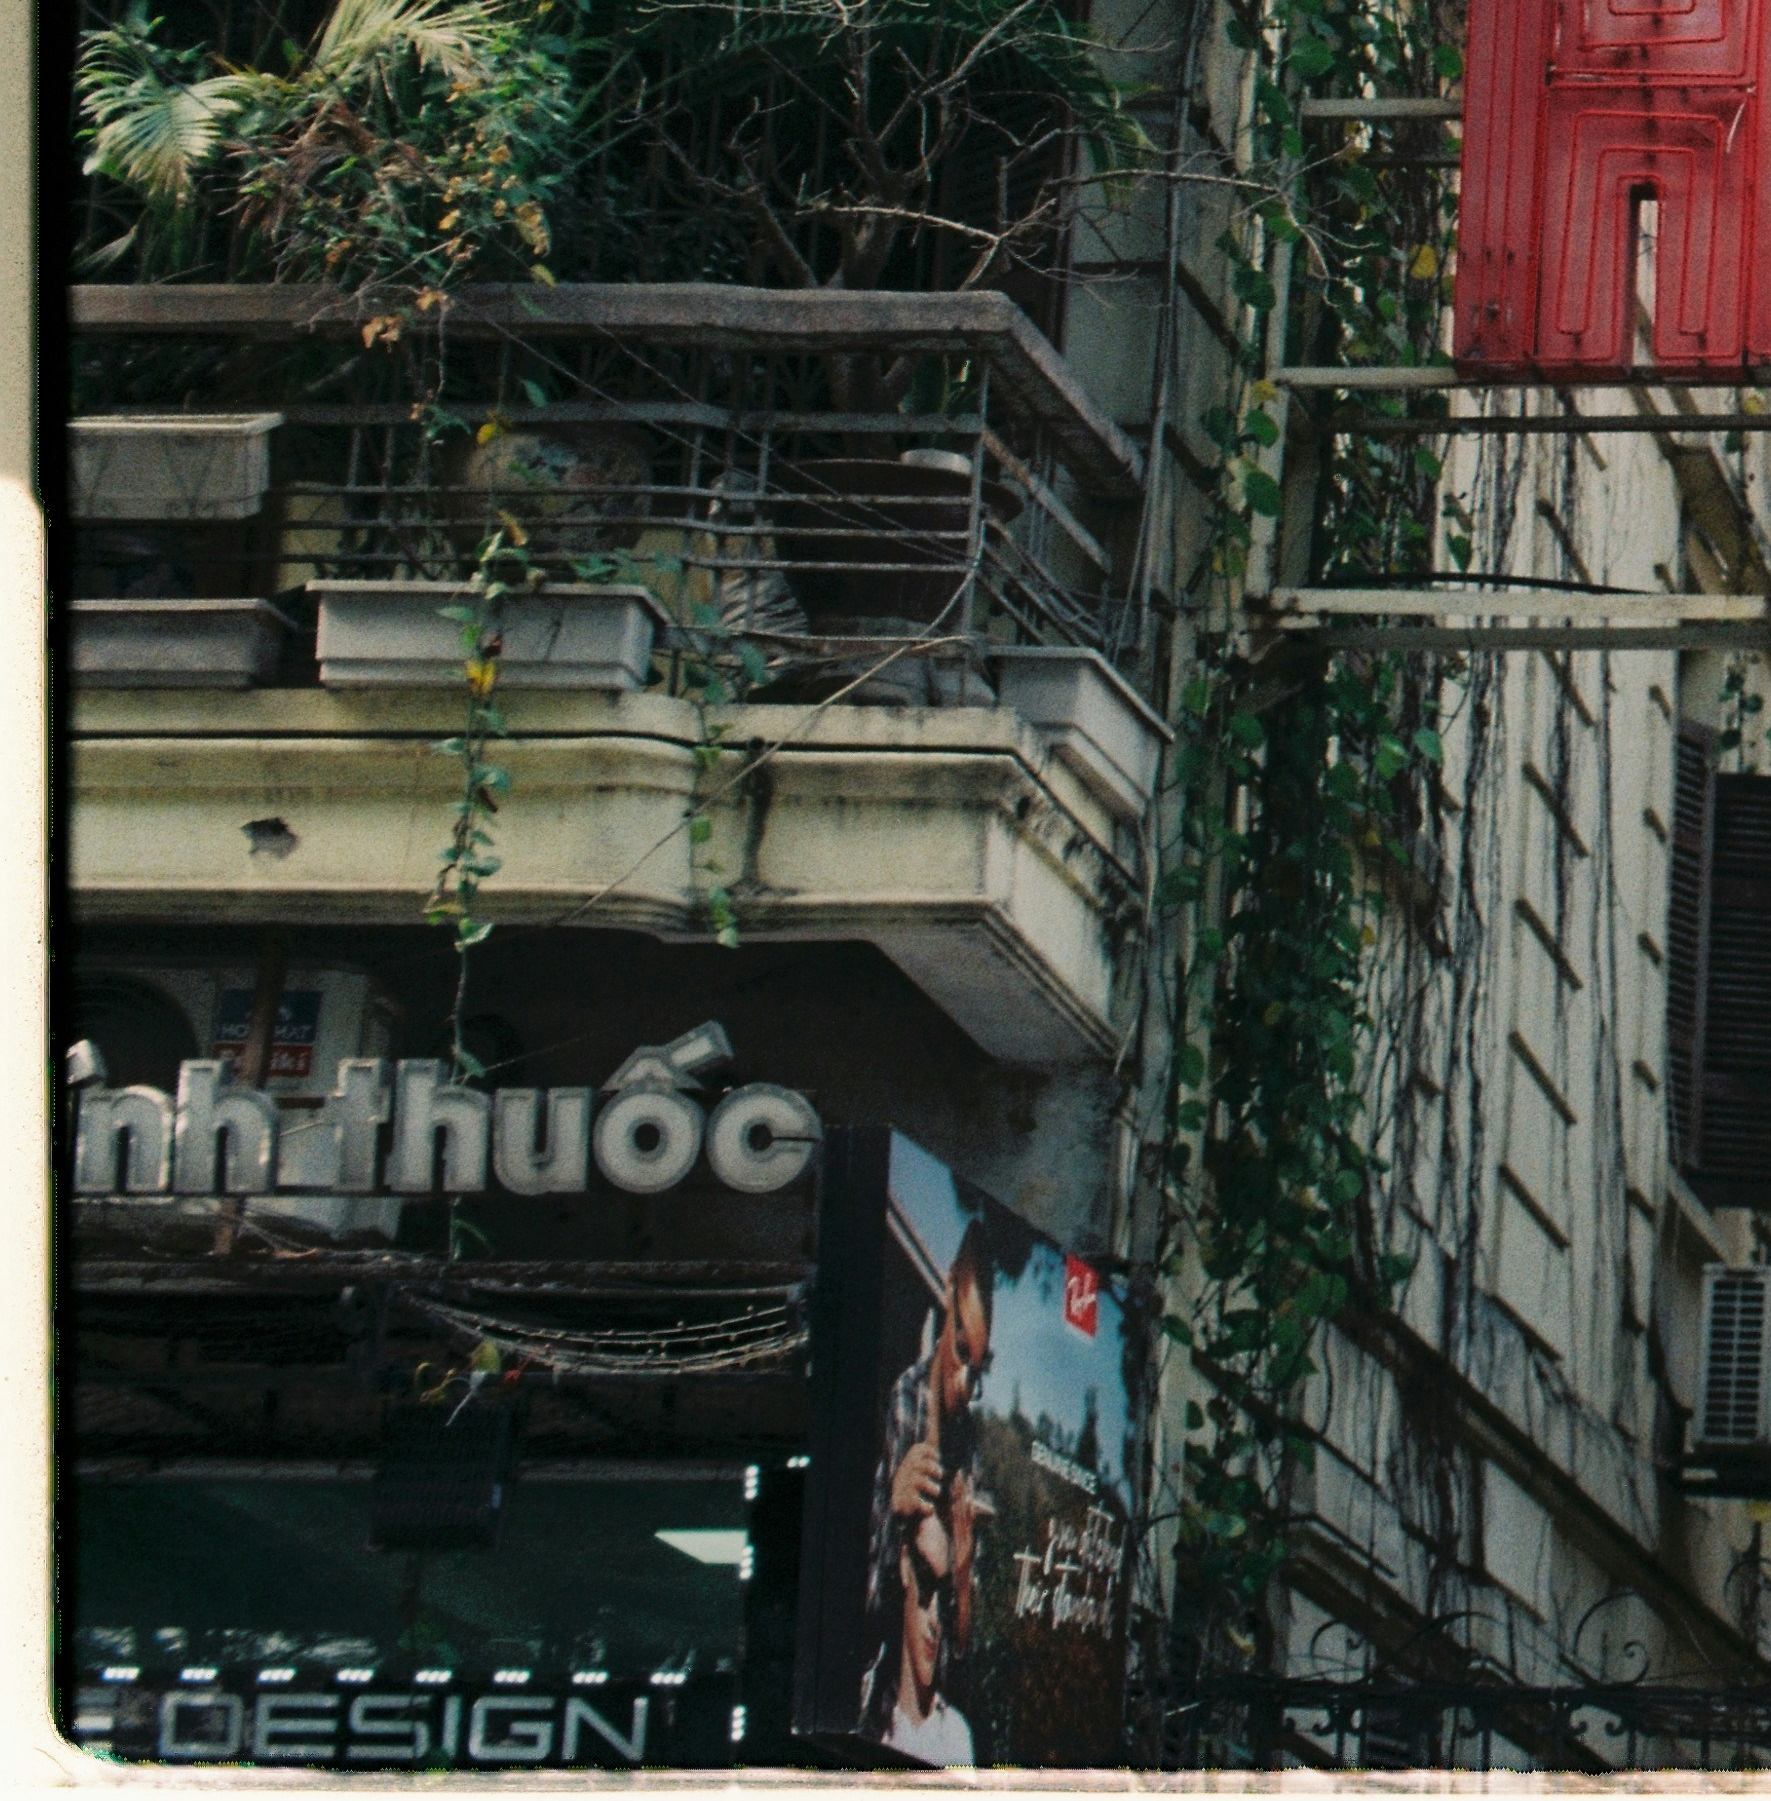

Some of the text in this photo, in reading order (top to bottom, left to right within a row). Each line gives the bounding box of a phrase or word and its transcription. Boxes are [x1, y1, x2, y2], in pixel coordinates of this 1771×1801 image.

[66, 1019, 823, 1195] nh thuốc
[157, 1691, 649, 1762] DESIGN
